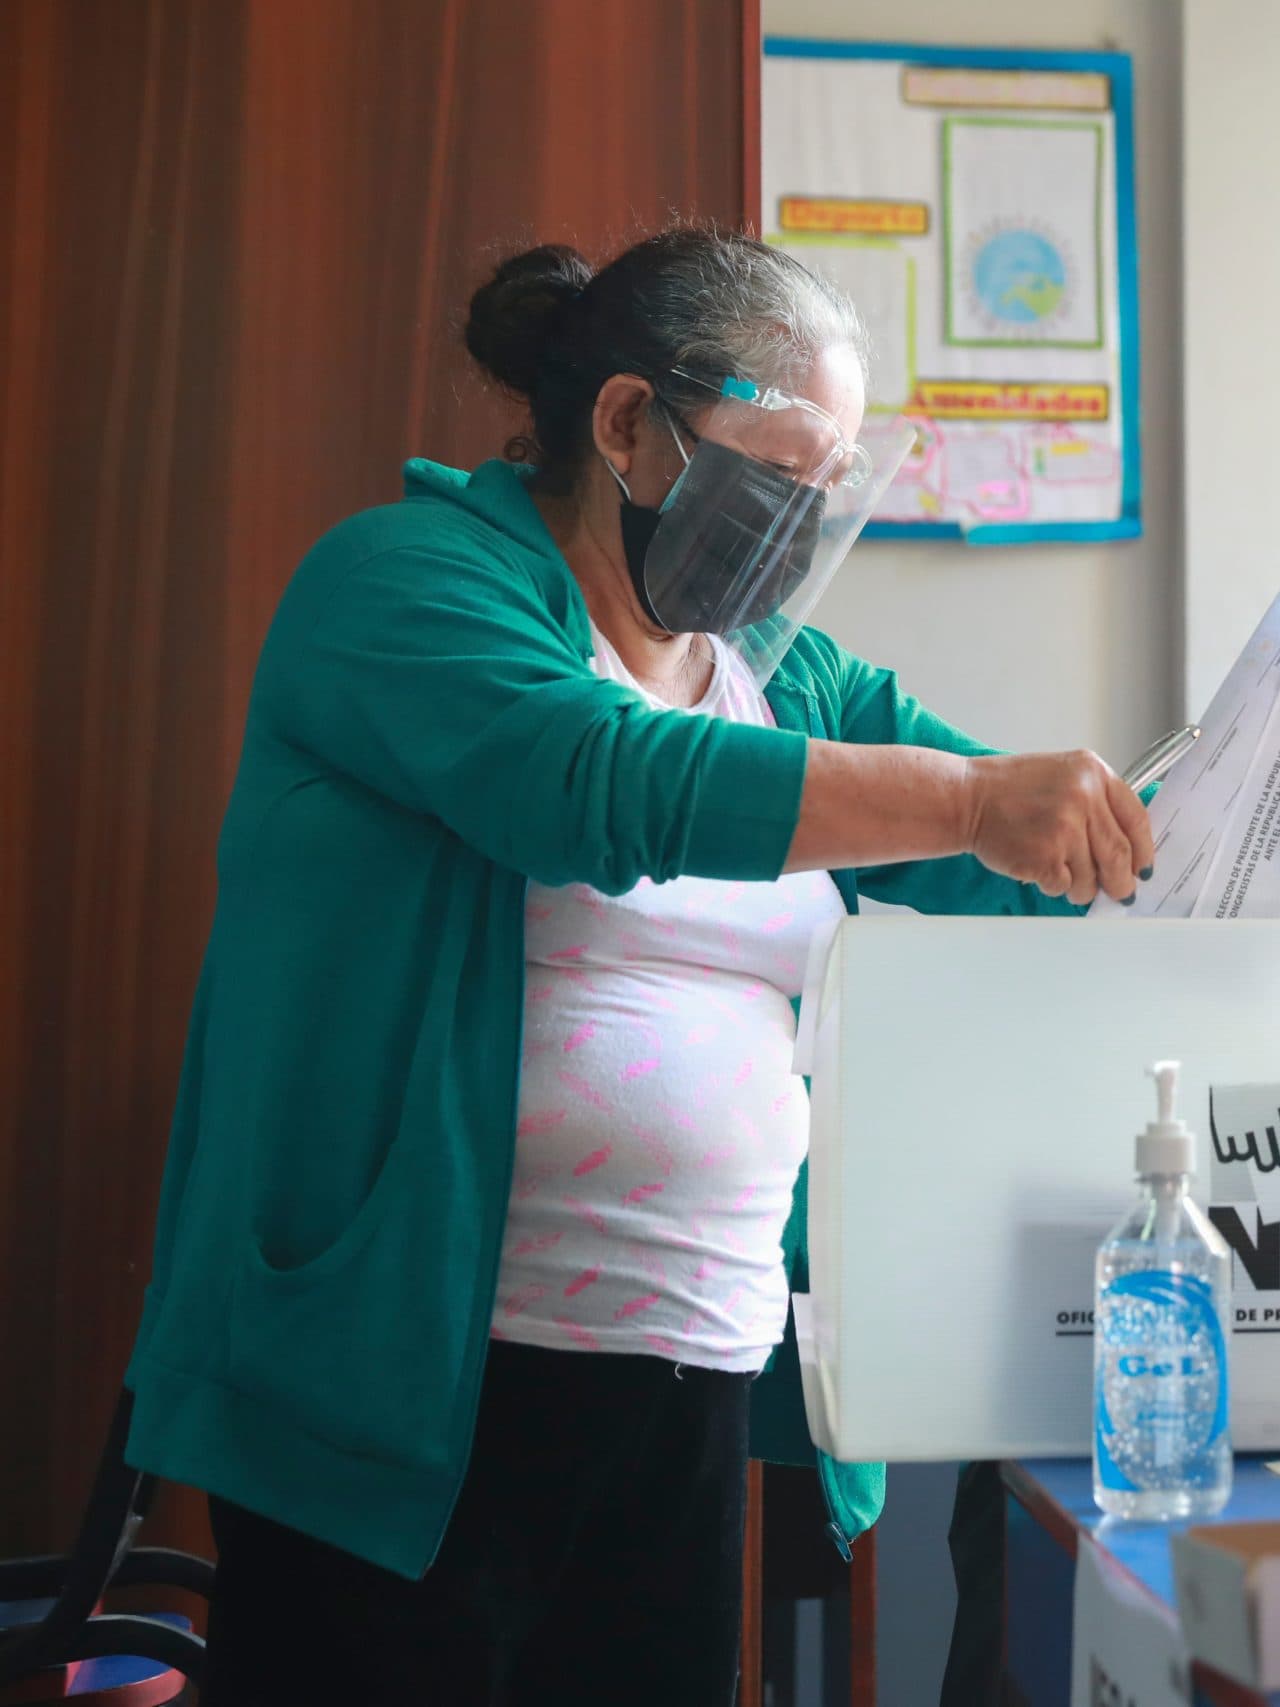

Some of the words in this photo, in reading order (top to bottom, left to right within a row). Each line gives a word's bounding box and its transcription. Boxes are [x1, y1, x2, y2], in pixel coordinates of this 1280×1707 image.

[1259, 789, 1270, 802] LA
[1254, 802, 1265, 815] DE
[1235, 814, 1260, 866] PRESIDENTE
[1254, 835, 1265, 849] LA
[1249, 847, 1261, 862] DE
[1262, 837, 1278, 861] ANTE
[1230, 864, 1241, 879] DE
[1227, 861, 1256, 921] ONGRESISTAS
[1236, 1308, 1257, 1321] DE
